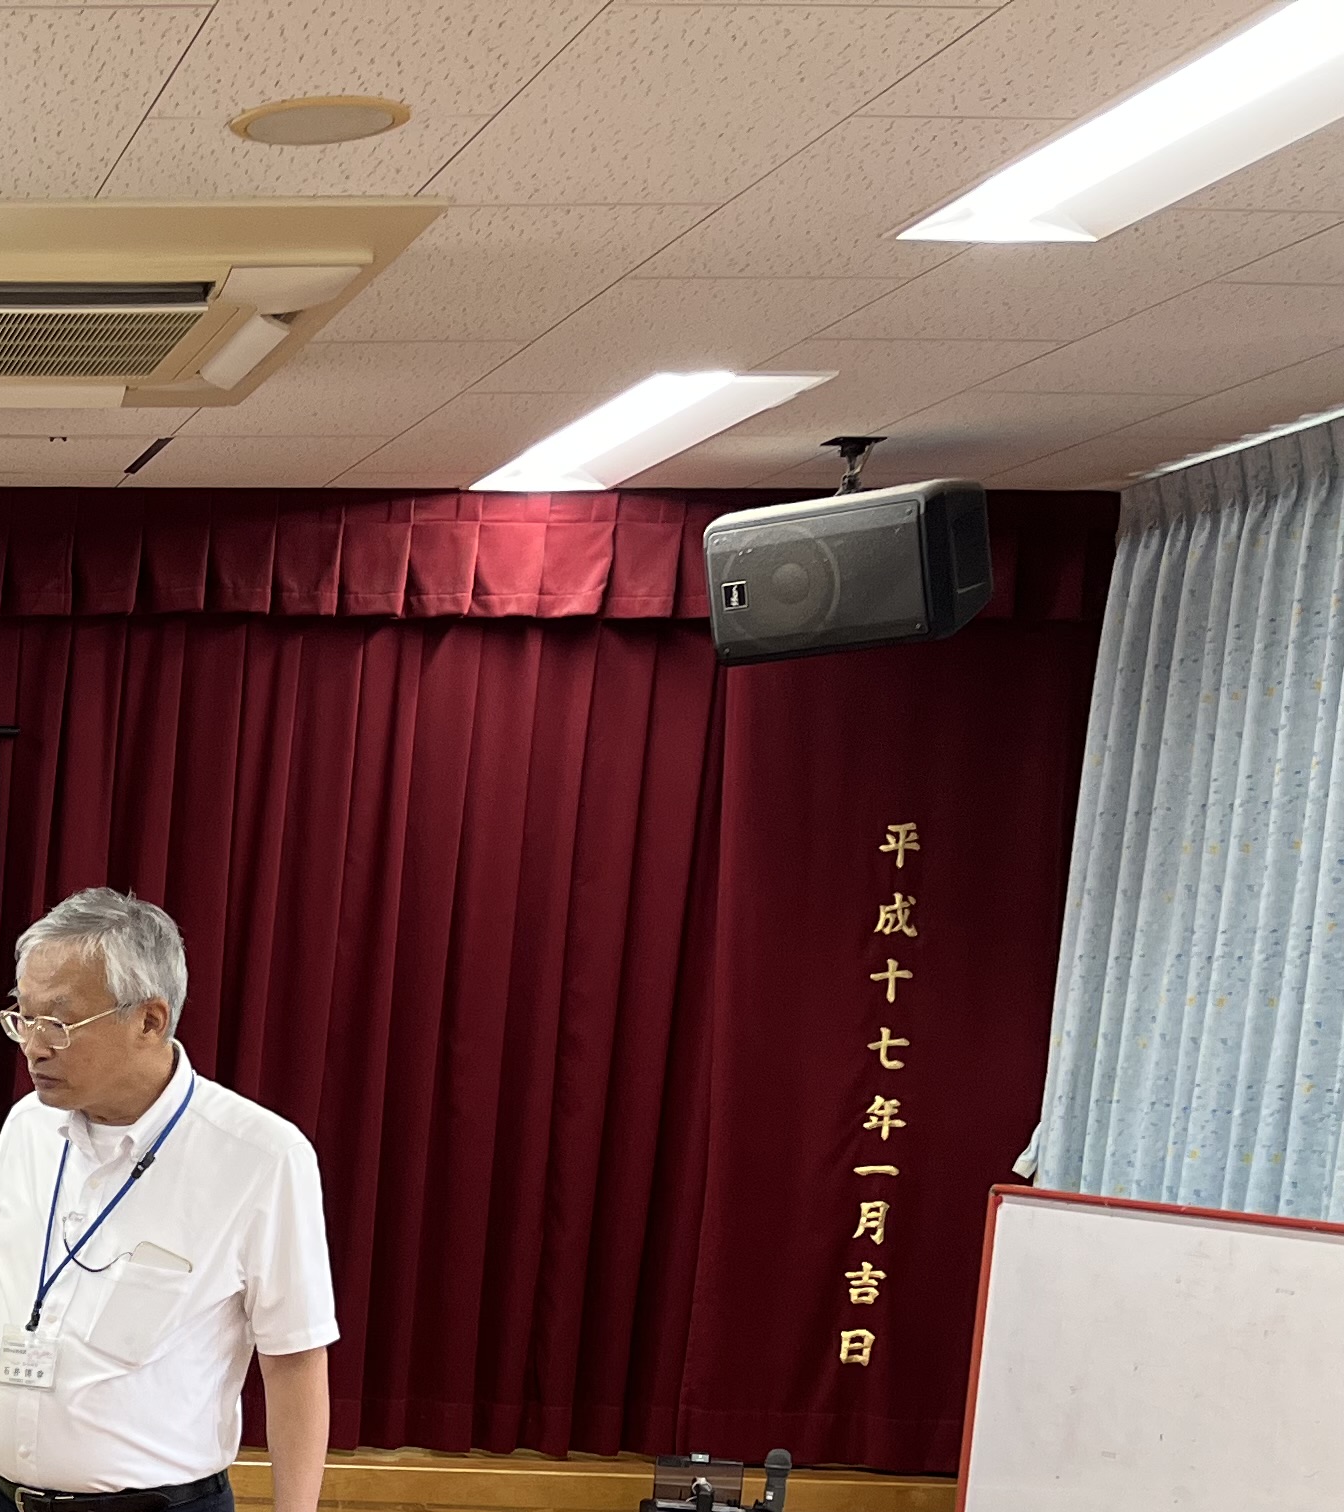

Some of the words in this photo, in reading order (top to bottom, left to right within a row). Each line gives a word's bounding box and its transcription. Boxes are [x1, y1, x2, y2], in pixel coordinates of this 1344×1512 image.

[839, 821, 921, 1366] 平成十七年一月吉日
